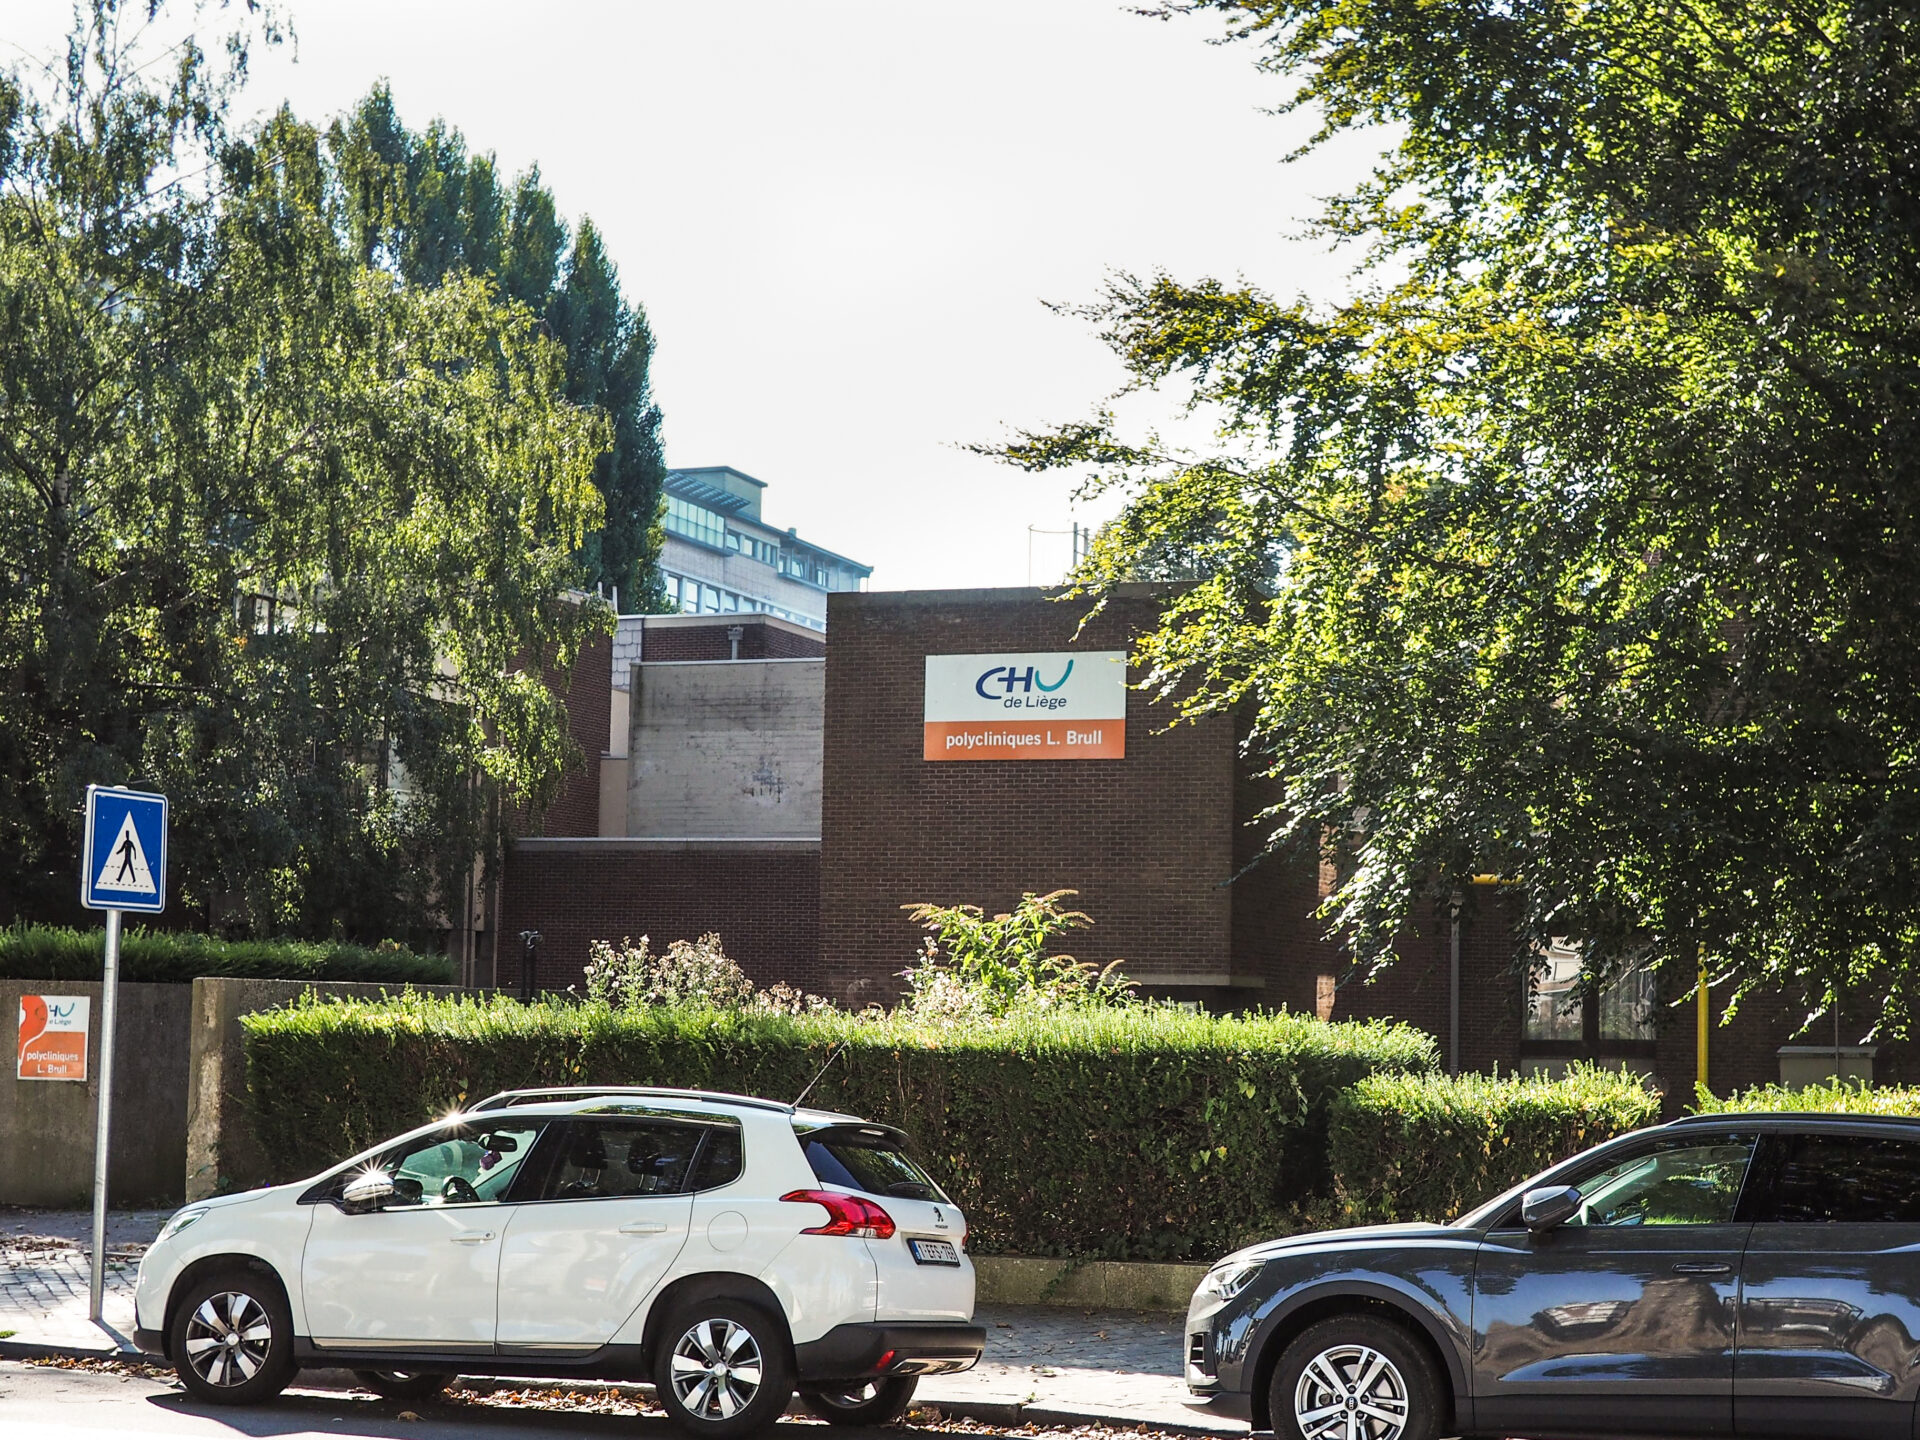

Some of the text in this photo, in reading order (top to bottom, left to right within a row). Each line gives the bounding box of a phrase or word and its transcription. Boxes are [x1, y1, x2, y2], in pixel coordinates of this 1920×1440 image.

[975, 659, 1074, 699] CHU
[1003, 695, 1067, 710] de Liège
[946, 730, 1102, 749] polycliniques L. Brull
[26, 1051, 78, 1062] polycliniques
[47, 1064, 67, 1073] Brull
